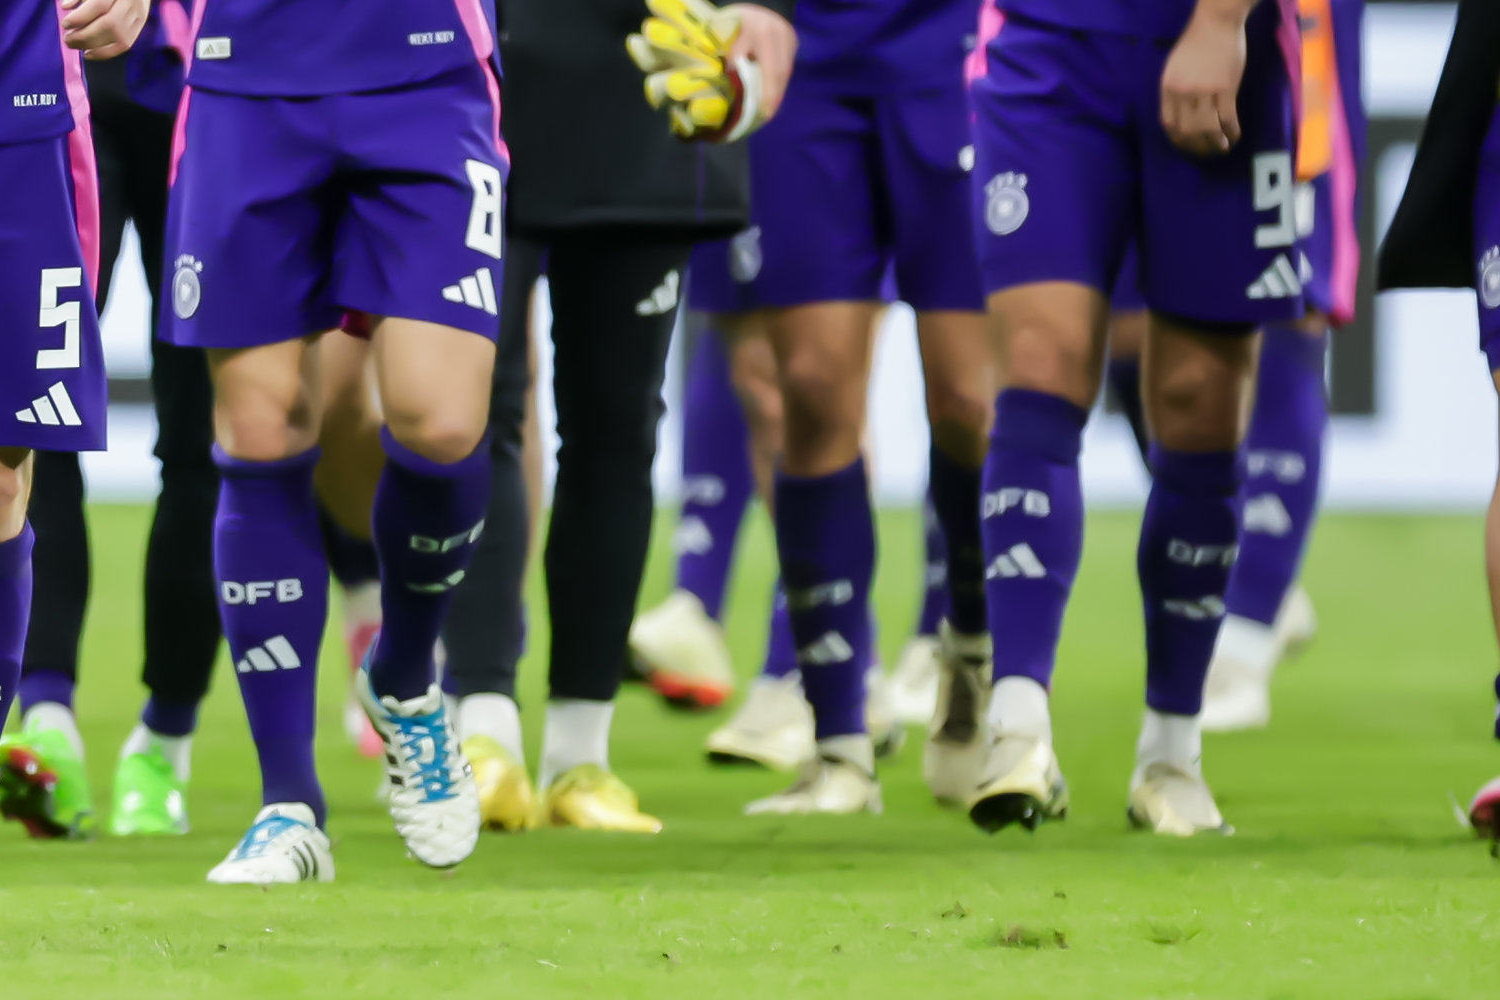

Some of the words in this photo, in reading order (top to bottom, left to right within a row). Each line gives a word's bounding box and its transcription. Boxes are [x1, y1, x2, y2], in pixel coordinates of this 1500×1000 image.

[464, 158, 502, 260] 8
[1252, 151, 1295, 249] 9
[36, 266, 82, 369] 5
[983, 487, 1051, 519] DFB
[221, 578, 304, 605] DFB
